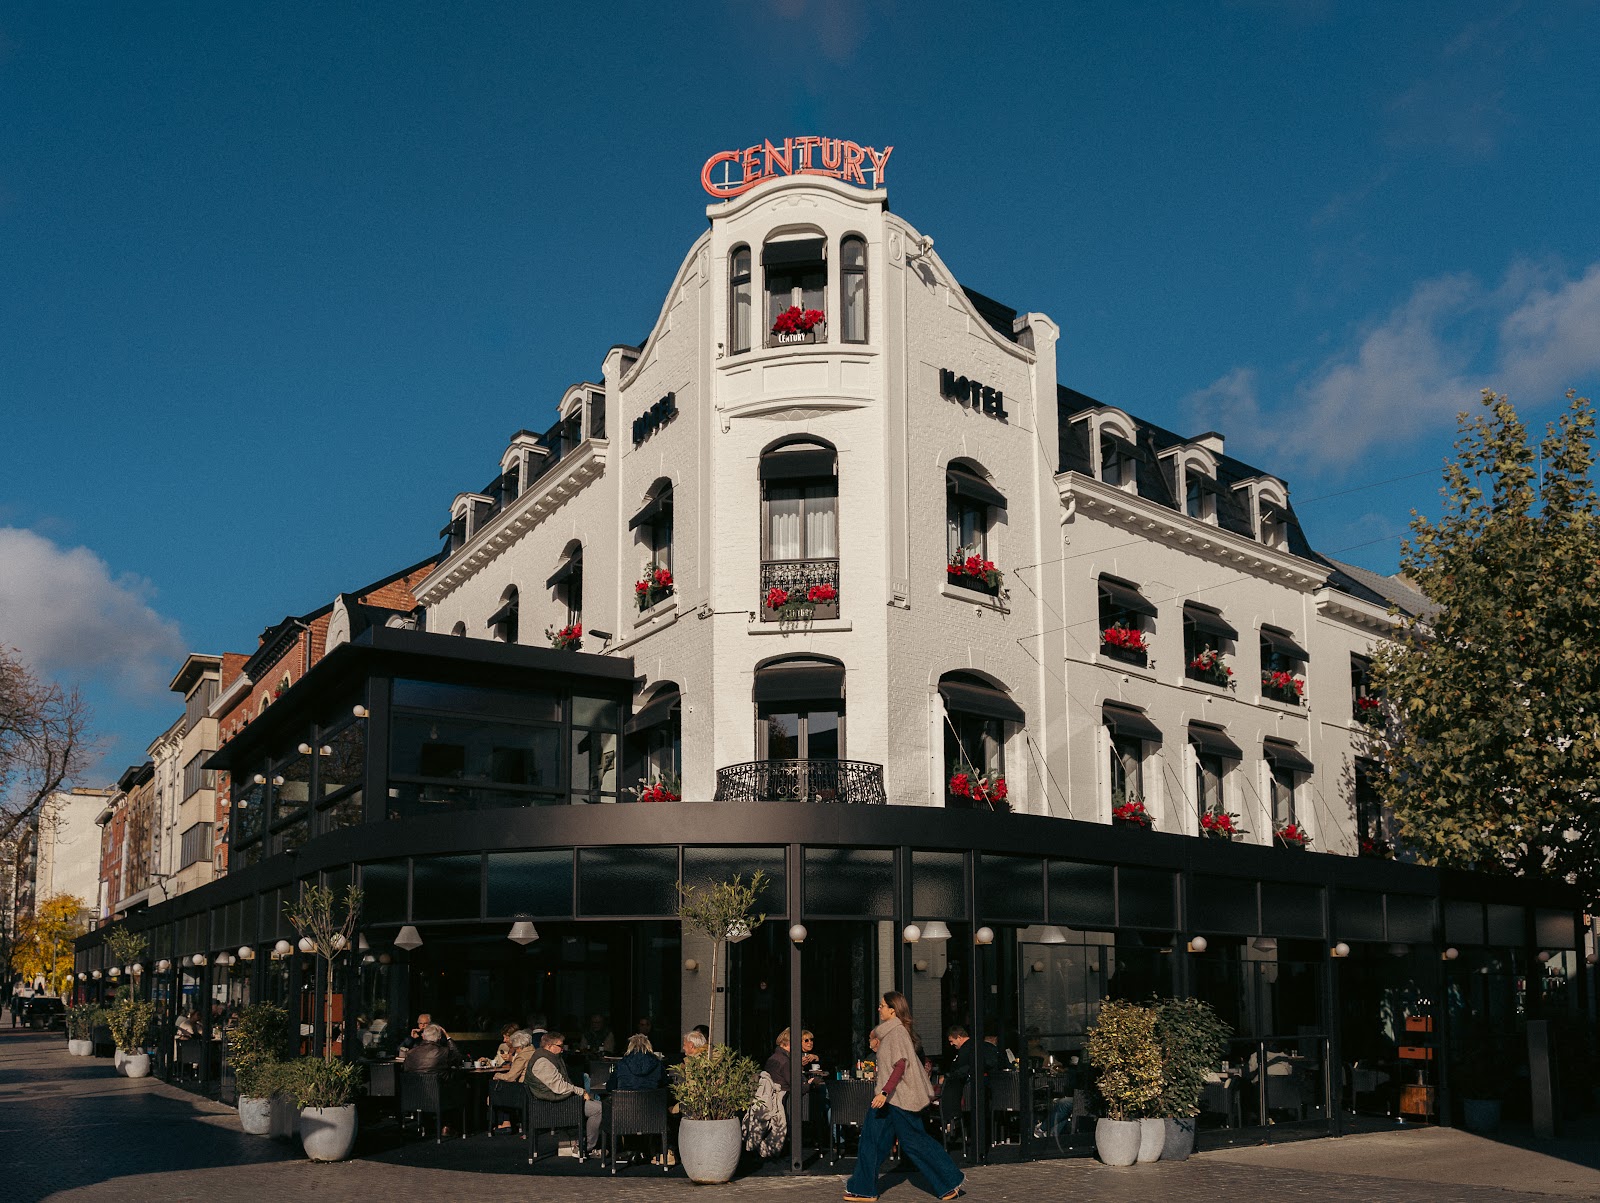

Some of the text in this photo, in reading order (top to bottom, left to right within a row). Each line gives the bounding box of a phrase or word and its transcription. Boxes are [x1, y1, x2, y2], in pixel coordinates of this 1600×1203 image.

[701, 136, 894, 198] CENTURY
[778, 333, 806, 343] CENTURY
[939, 368, 1008, 419] HOTEL
